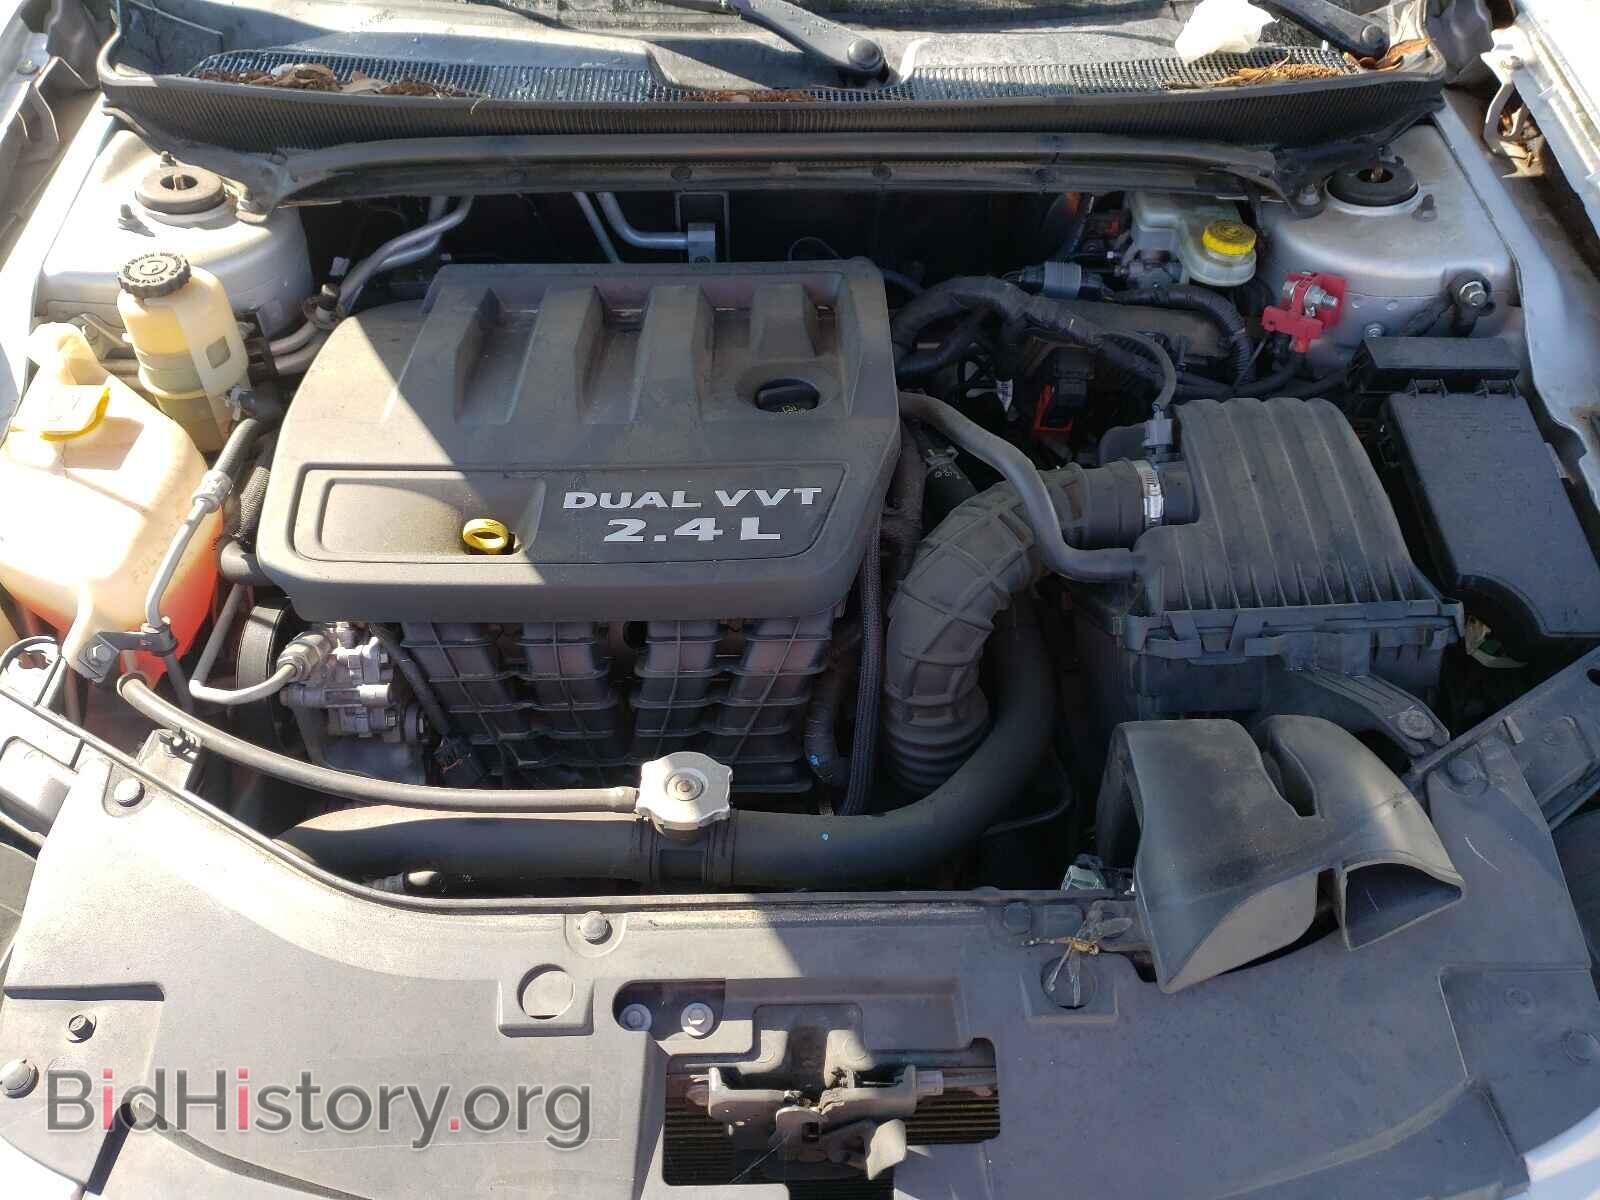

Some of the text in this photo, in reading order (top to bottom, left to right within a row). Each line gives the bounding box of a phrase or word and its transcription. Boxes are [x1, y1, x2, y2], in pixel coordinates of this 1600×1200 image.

[563, 488, 822, 508] DUAL VVT
[604, 517, 780, 541] 2.4 L
